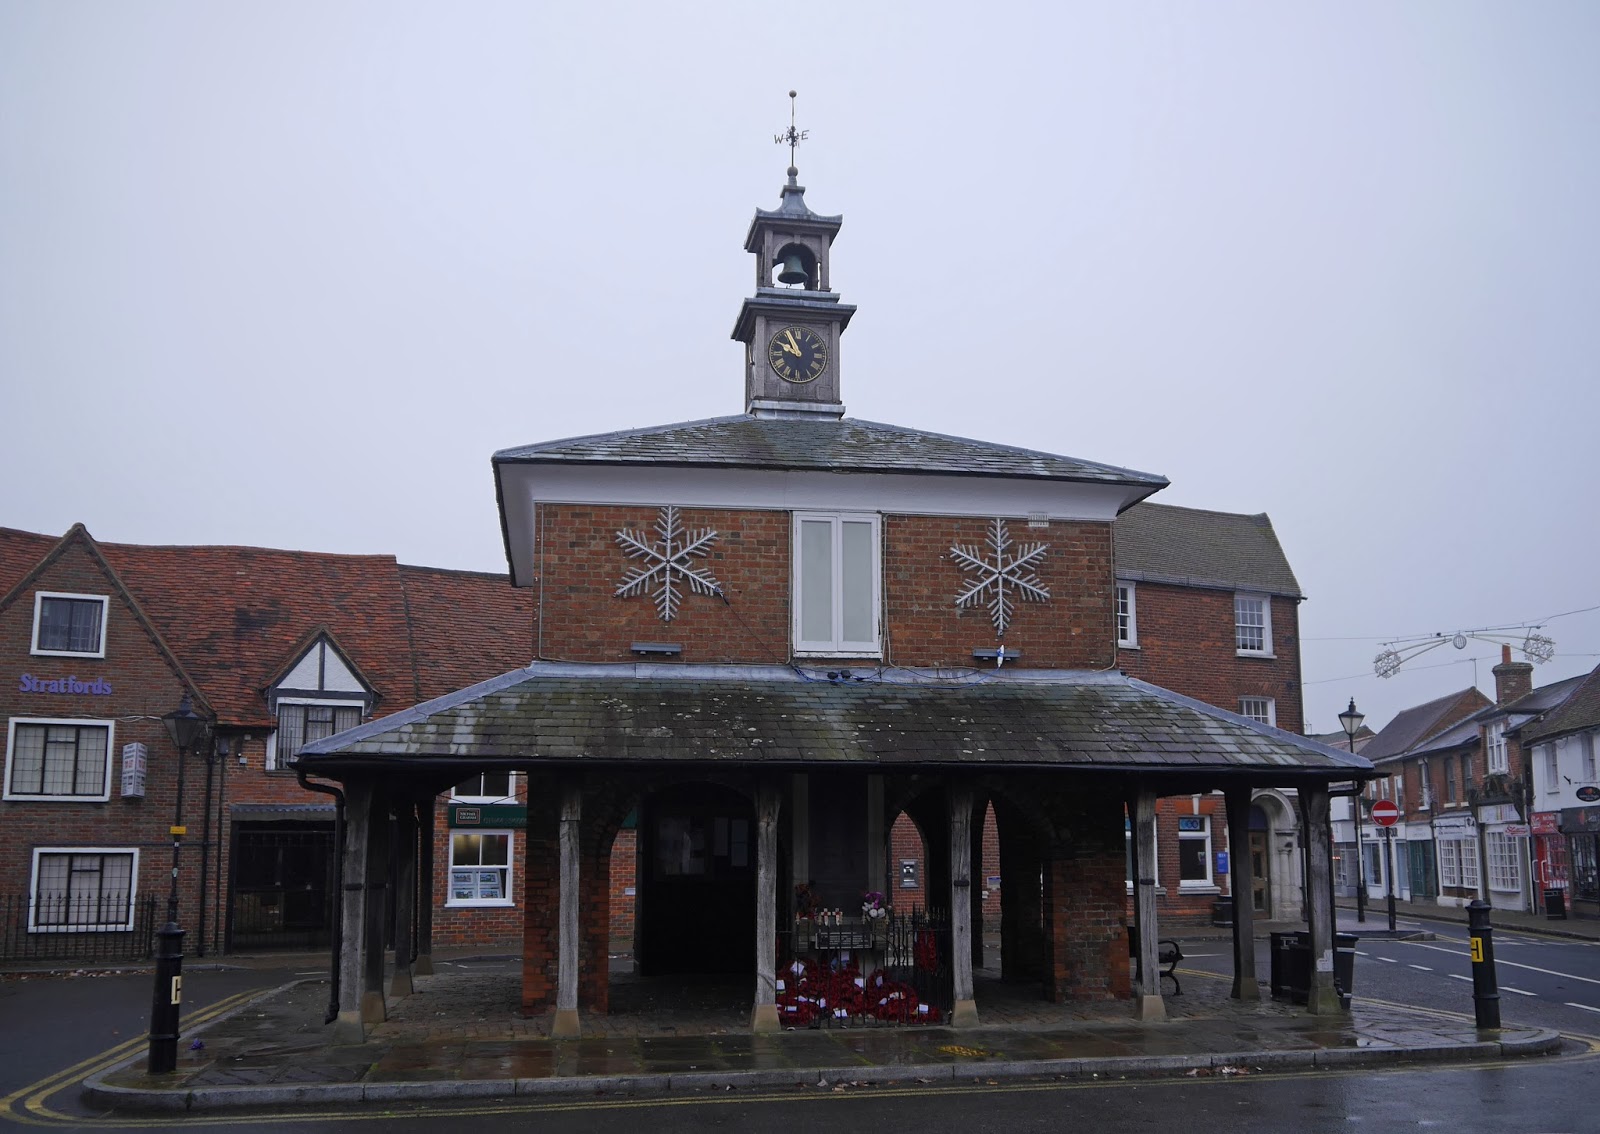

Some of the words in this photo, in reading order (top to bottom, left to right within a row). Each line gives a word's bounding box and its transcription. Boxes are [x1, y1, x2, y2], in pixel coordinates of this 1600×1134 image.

[774, 134, 784, 145] W
[801, 129, 810, 141] E
[18, 673, 113, 696] Stratfords
